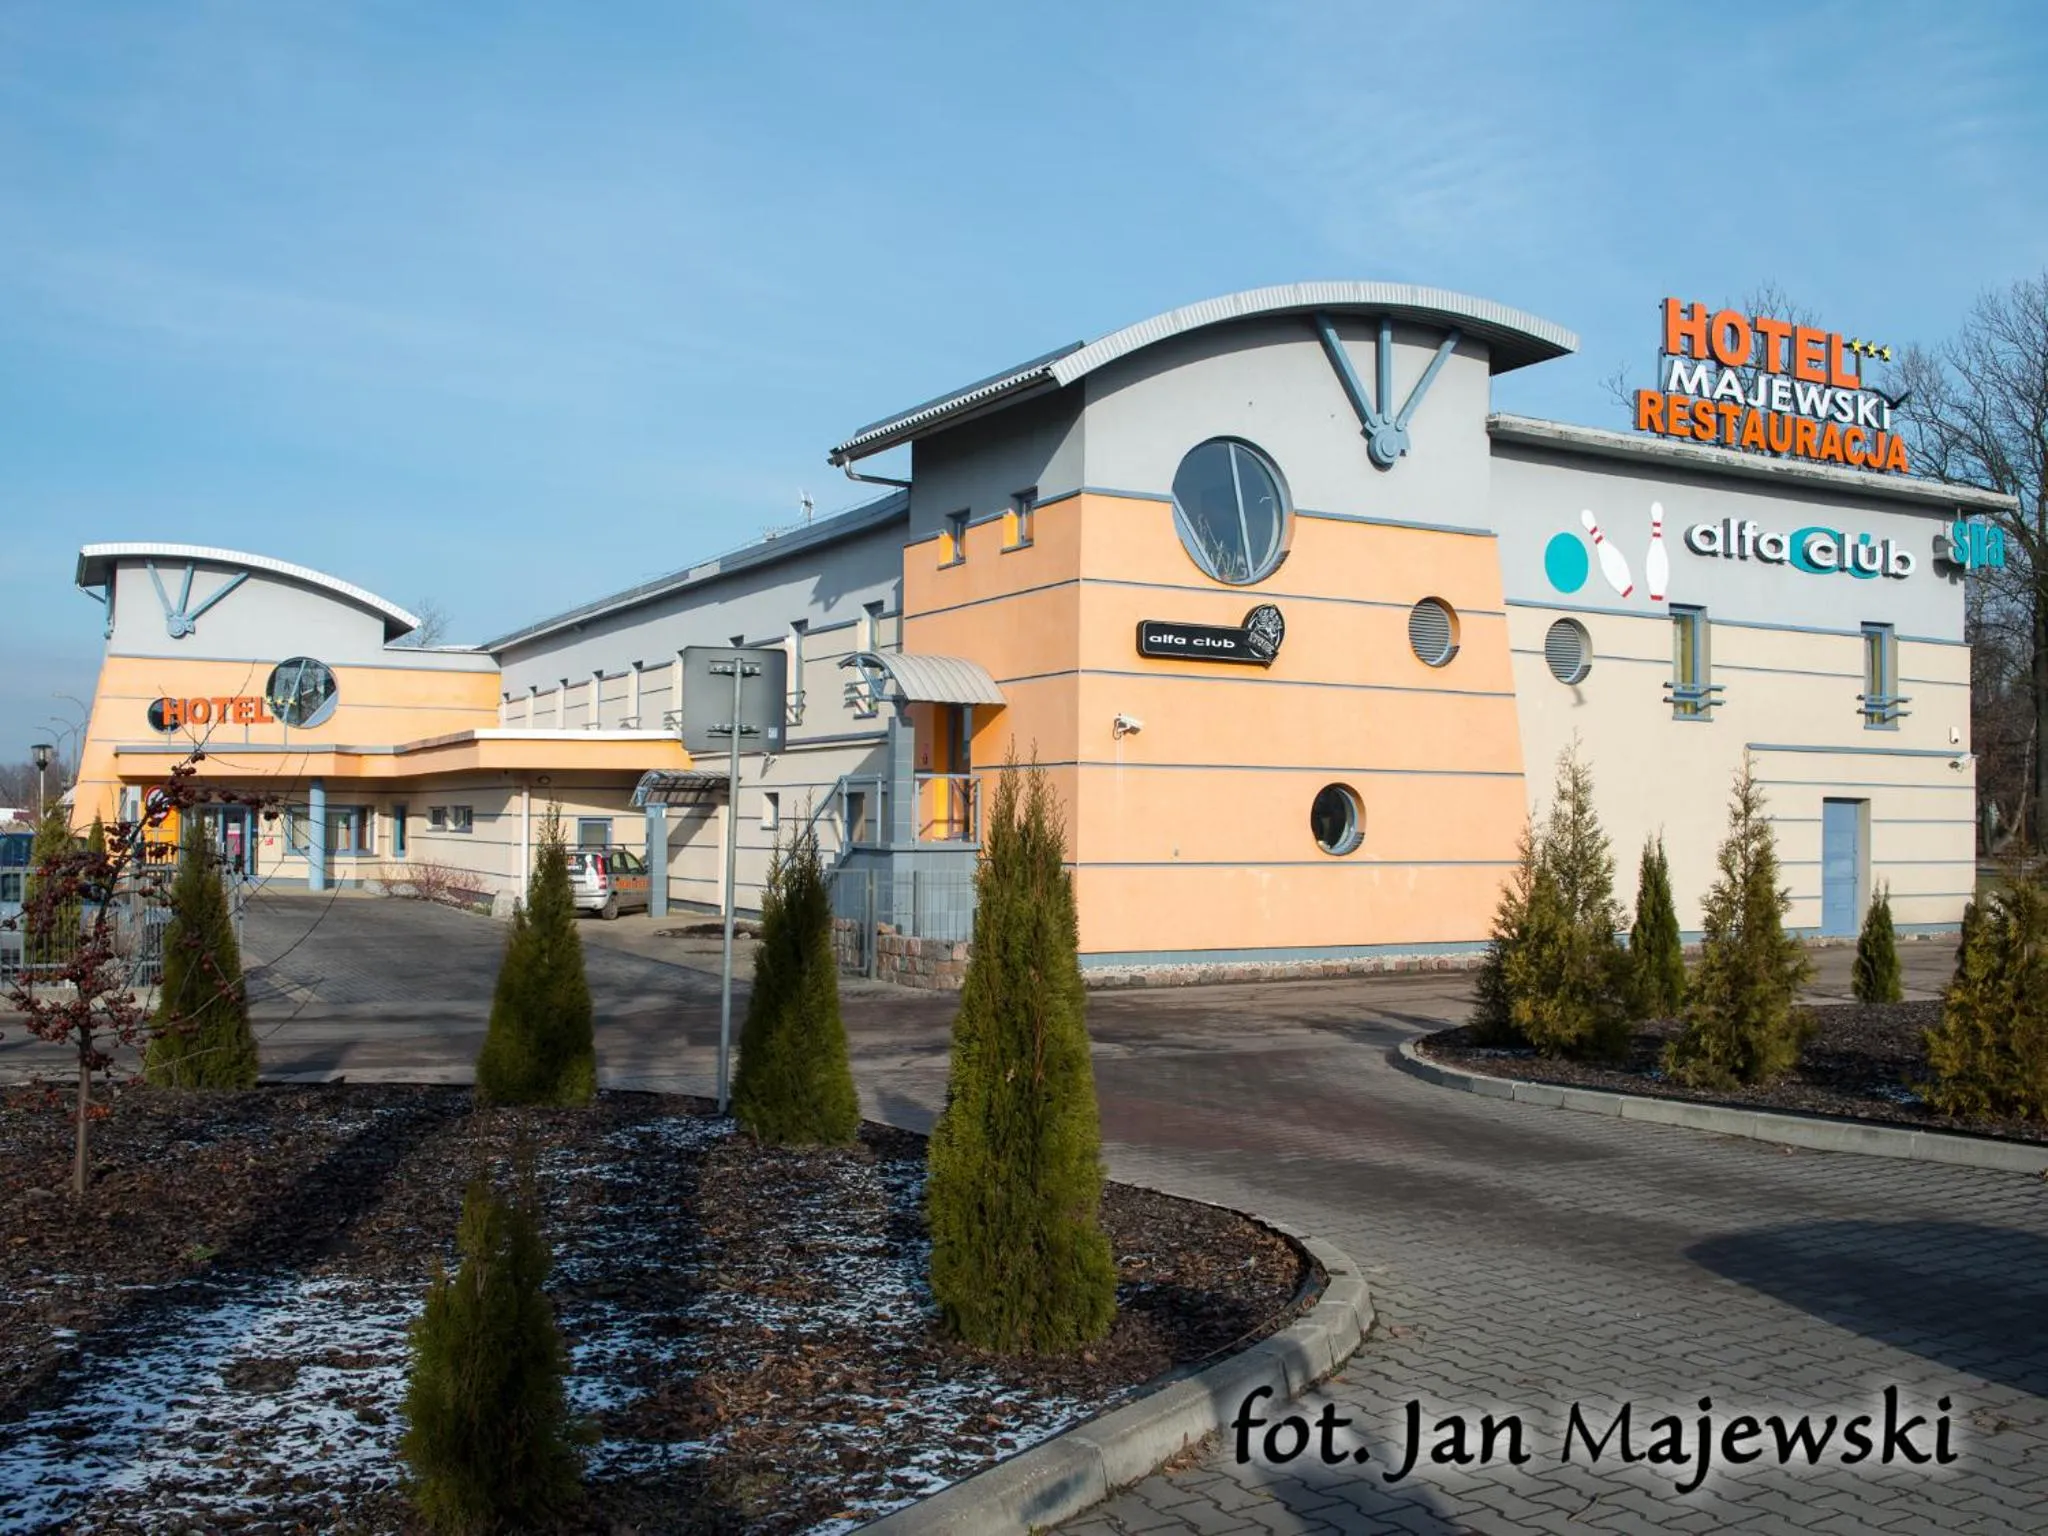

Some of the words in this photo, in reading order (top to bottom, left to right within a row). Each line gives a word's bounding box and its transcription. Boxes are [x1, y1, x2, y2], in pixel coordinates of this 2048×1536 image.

[1664, 297, 1861, 390] HOTEL
[1668, 360, 1891, 430] MAJEWSKI
[1635, 389, 1910, 473] RESTAURACJA
[1687, 518, 1791, 564] alfa
[1805, 532, 1917, 578] club
[1149, 633, 1187, 646] alfa
[1192, 636, 1236, 649] club
[161, 696, 275, 726] HOTEL
